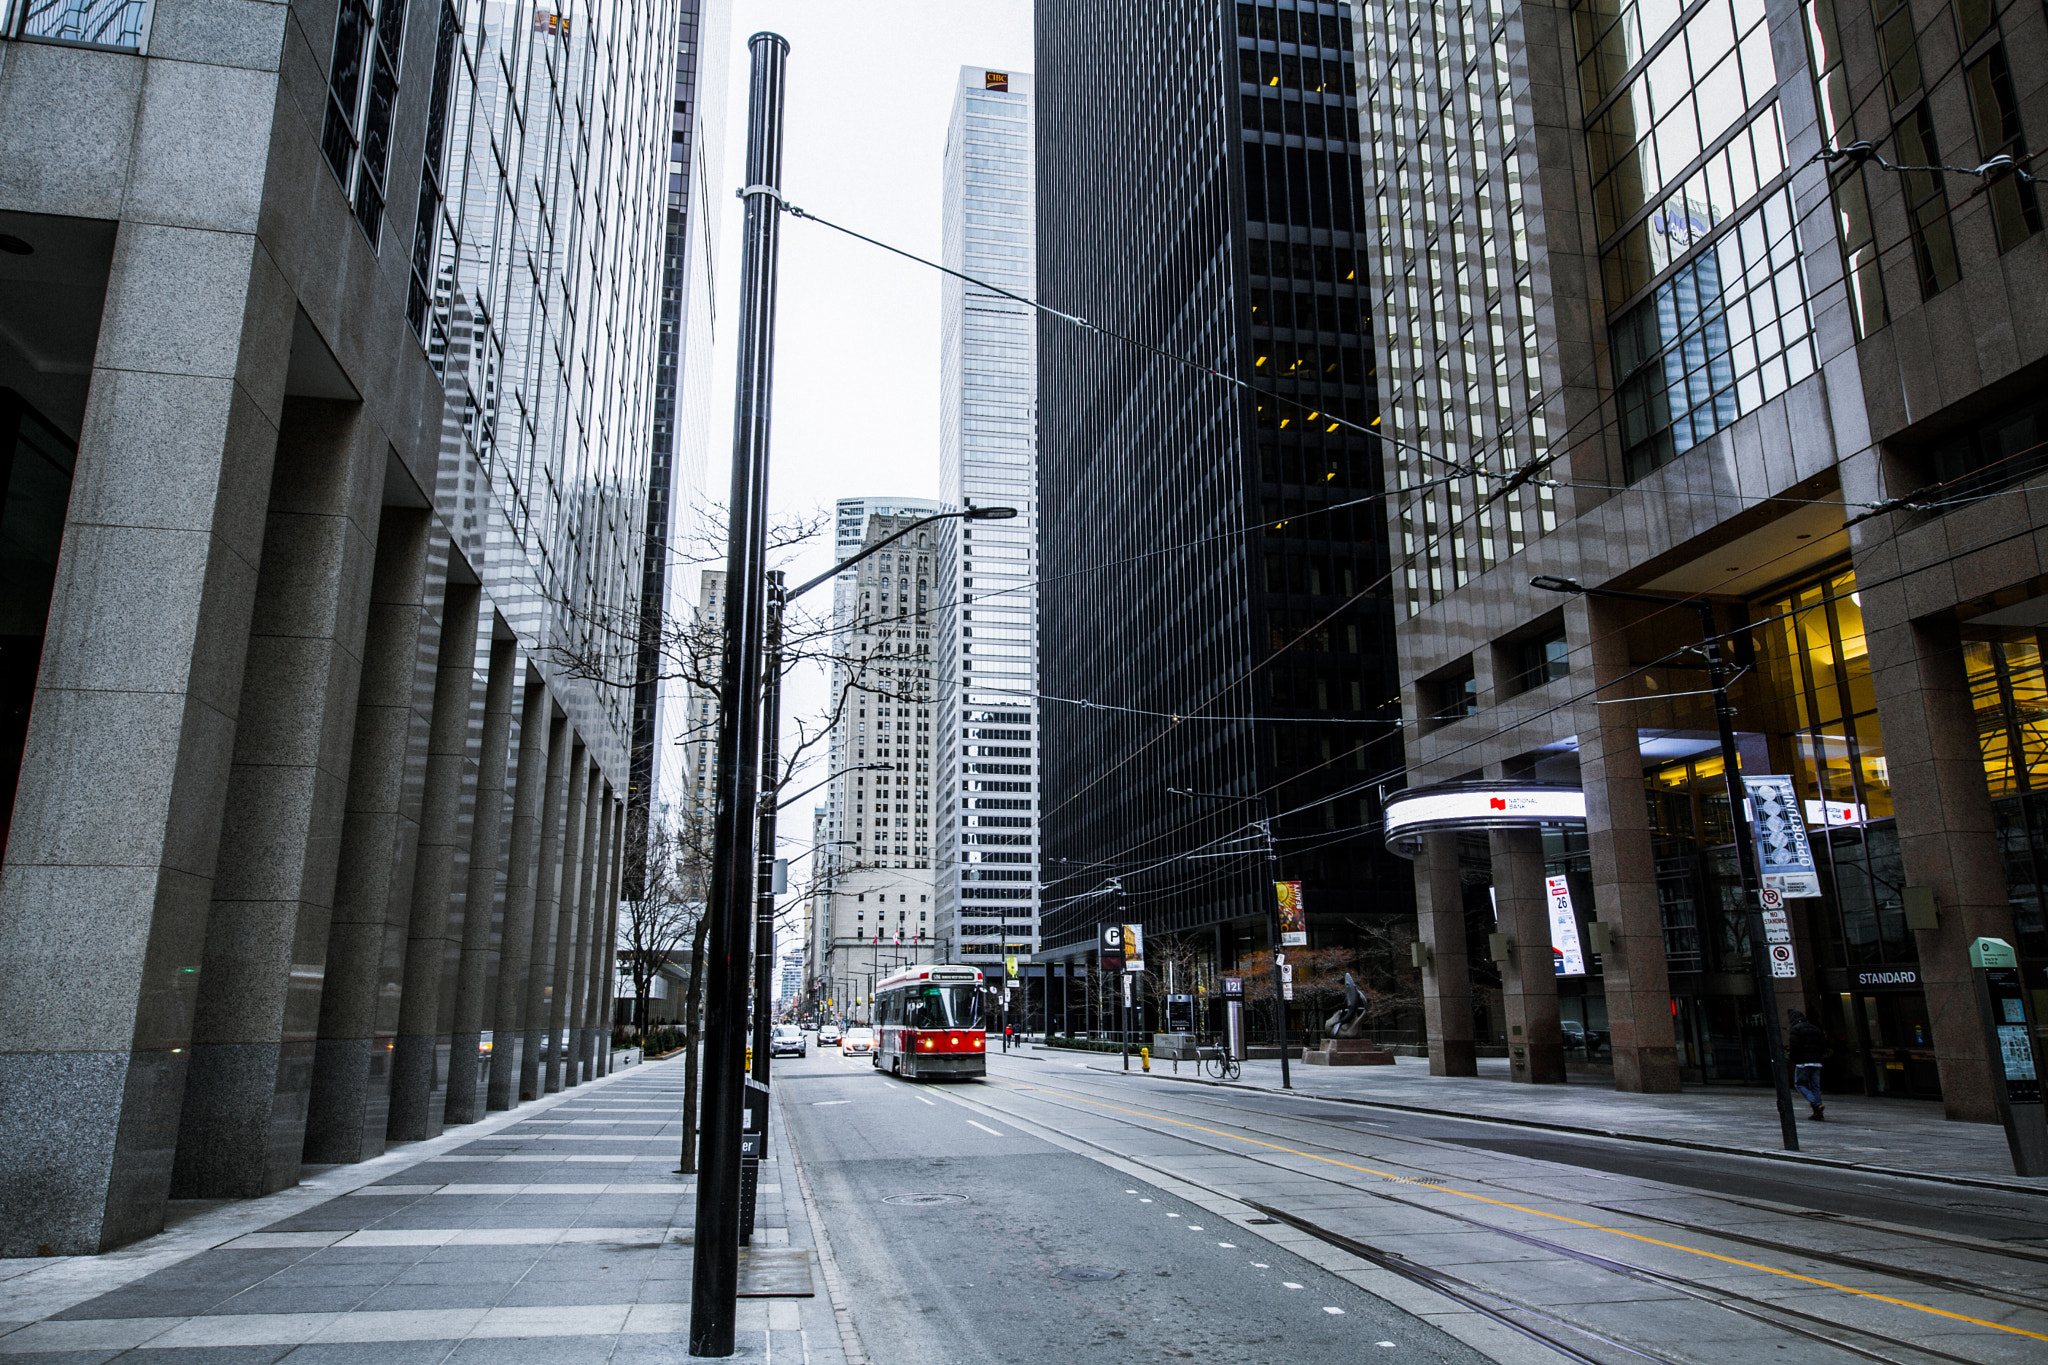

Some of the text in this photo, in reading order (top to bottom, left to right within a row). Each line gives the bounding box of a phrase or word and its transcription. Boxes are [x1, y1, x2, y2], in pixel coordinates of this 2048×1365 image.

[987, 73, 1007, 83] CIBC
[1780, 780, 1812, 867] OPPORTUNITY
[1294, 883, 1303, 910] BEAUTY
[1557, 896, 1568, 909] 26
[1110, 930, 1119, 942] P
[1859, 971, 1916, 984] STANDARD
[1227, 981, 1240, 991] 121
